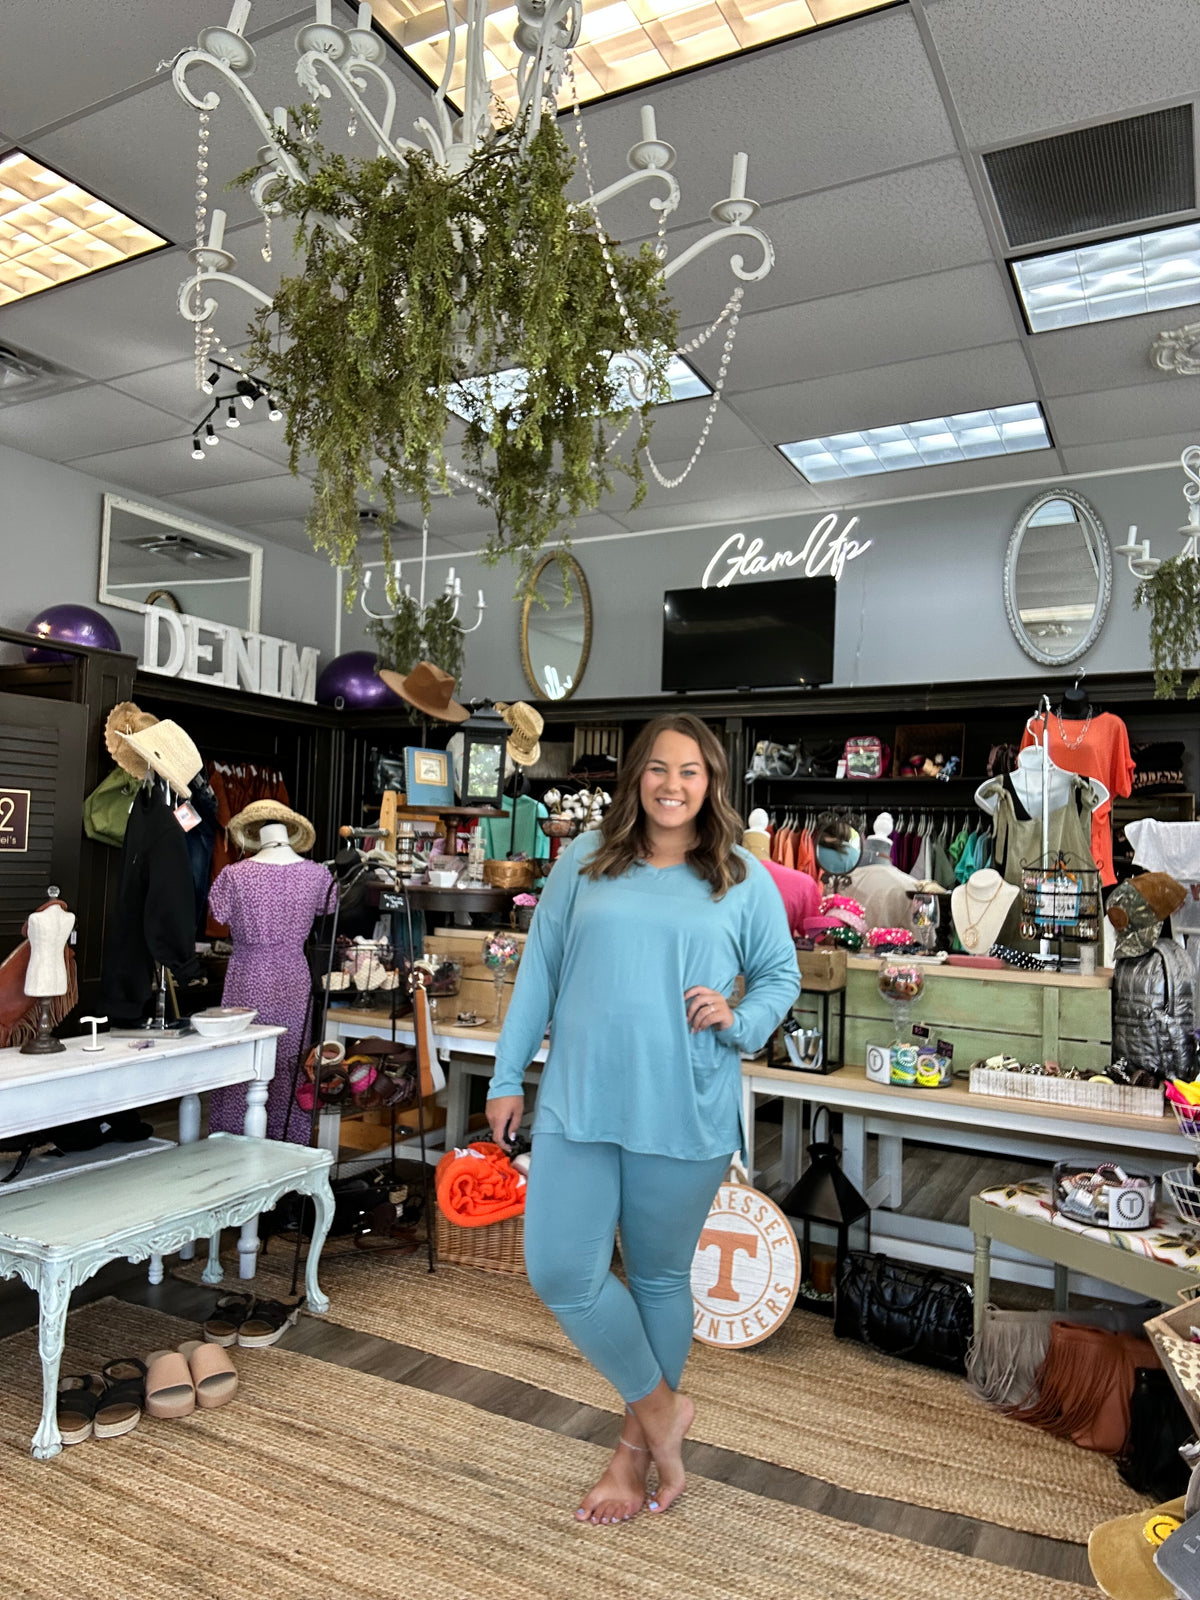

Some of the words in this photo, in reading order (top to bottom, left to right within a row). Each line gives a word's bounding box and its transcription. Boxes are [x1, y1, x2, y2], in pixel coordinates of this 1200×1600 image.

[702, 532, 804, 589] Glam
[802, 513, 873, 582] Up
[138, 603, 321, 706] DENIM
[698, 1227, 759, 1303] T
